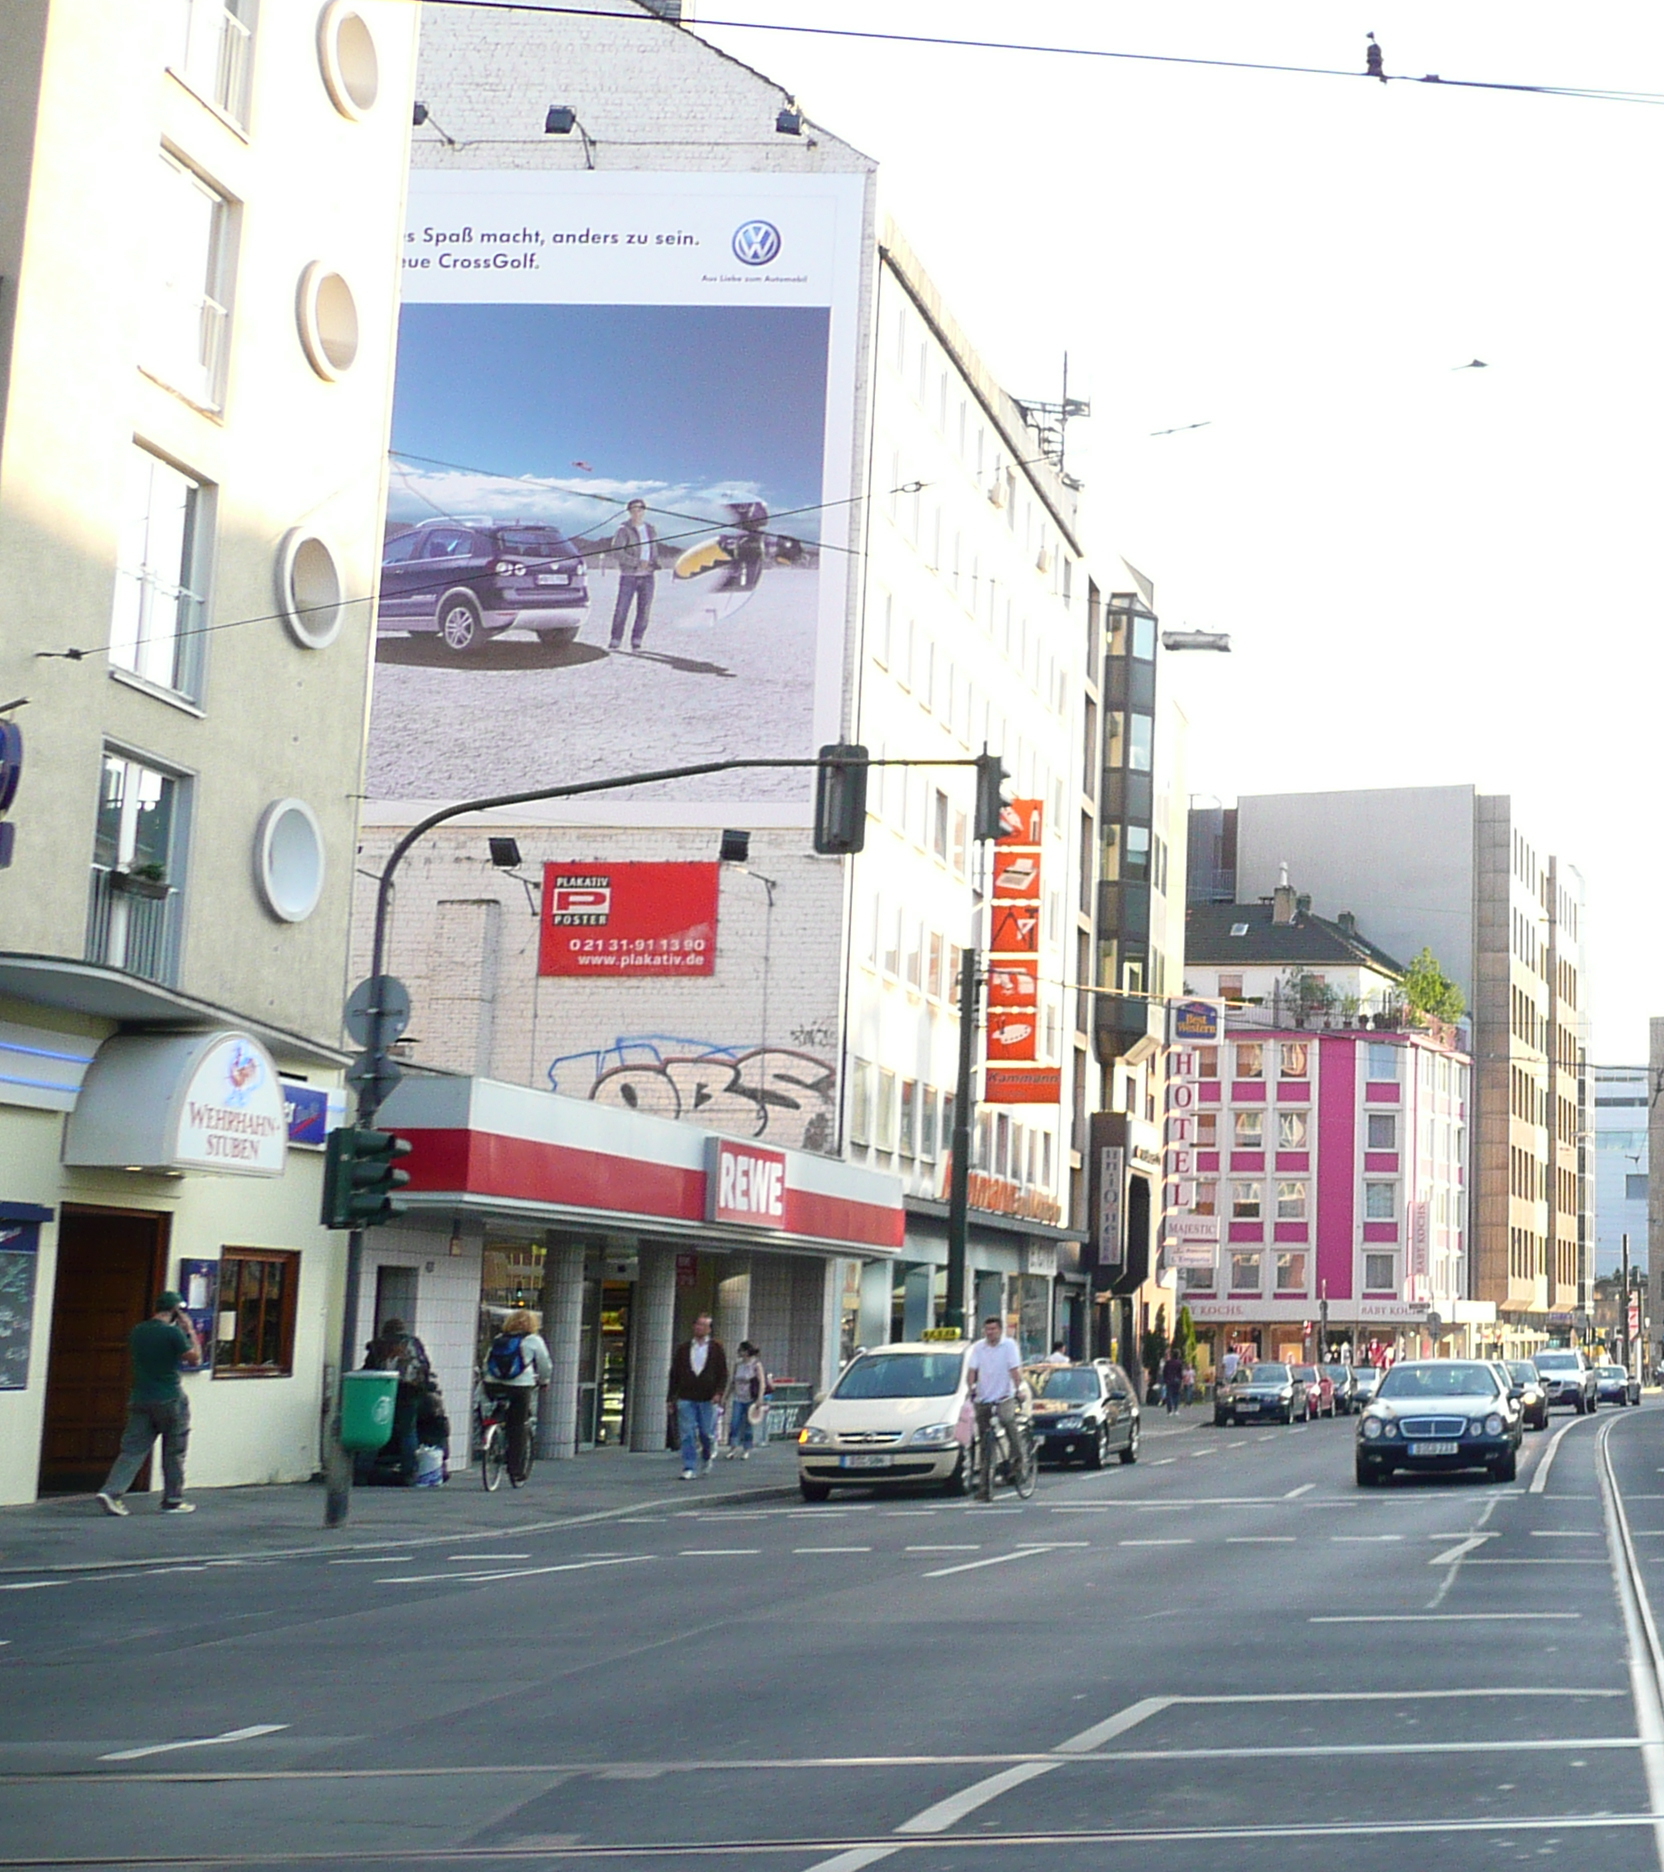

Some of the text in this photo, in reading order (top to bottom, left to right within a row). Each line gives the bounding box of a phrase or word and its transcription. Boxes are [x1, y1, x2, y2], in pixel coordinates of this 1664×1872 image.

[422, 226, 474, 248] Spaß
[480, 226, 546, 247] macht,
[552, 228, 619, 245] anders
[625, 232, 648, 246] zu
[655, 230, 701, 247] sein.
[438, 252, 541, 270] CrossGolf.
[556, 877, 609, 887] PLAKATIV
[553, 915, 607, 925] POSTER
[577, 953, 705, 968] www.plakativ.de
[1186, 1013, 1207, 1024] Best
[1177, 1023, 1217, 1034] Western
[188, 1101, 282, 1138] WEHRHAHN-
[1173, 1052, 1193, 1207] HOTEL
[204, 1133, 262, 1160] STUBEN
[719, 1151, 784, 1217] REWE
[1168, 1223, 1216, 1235] MAJESTIC
